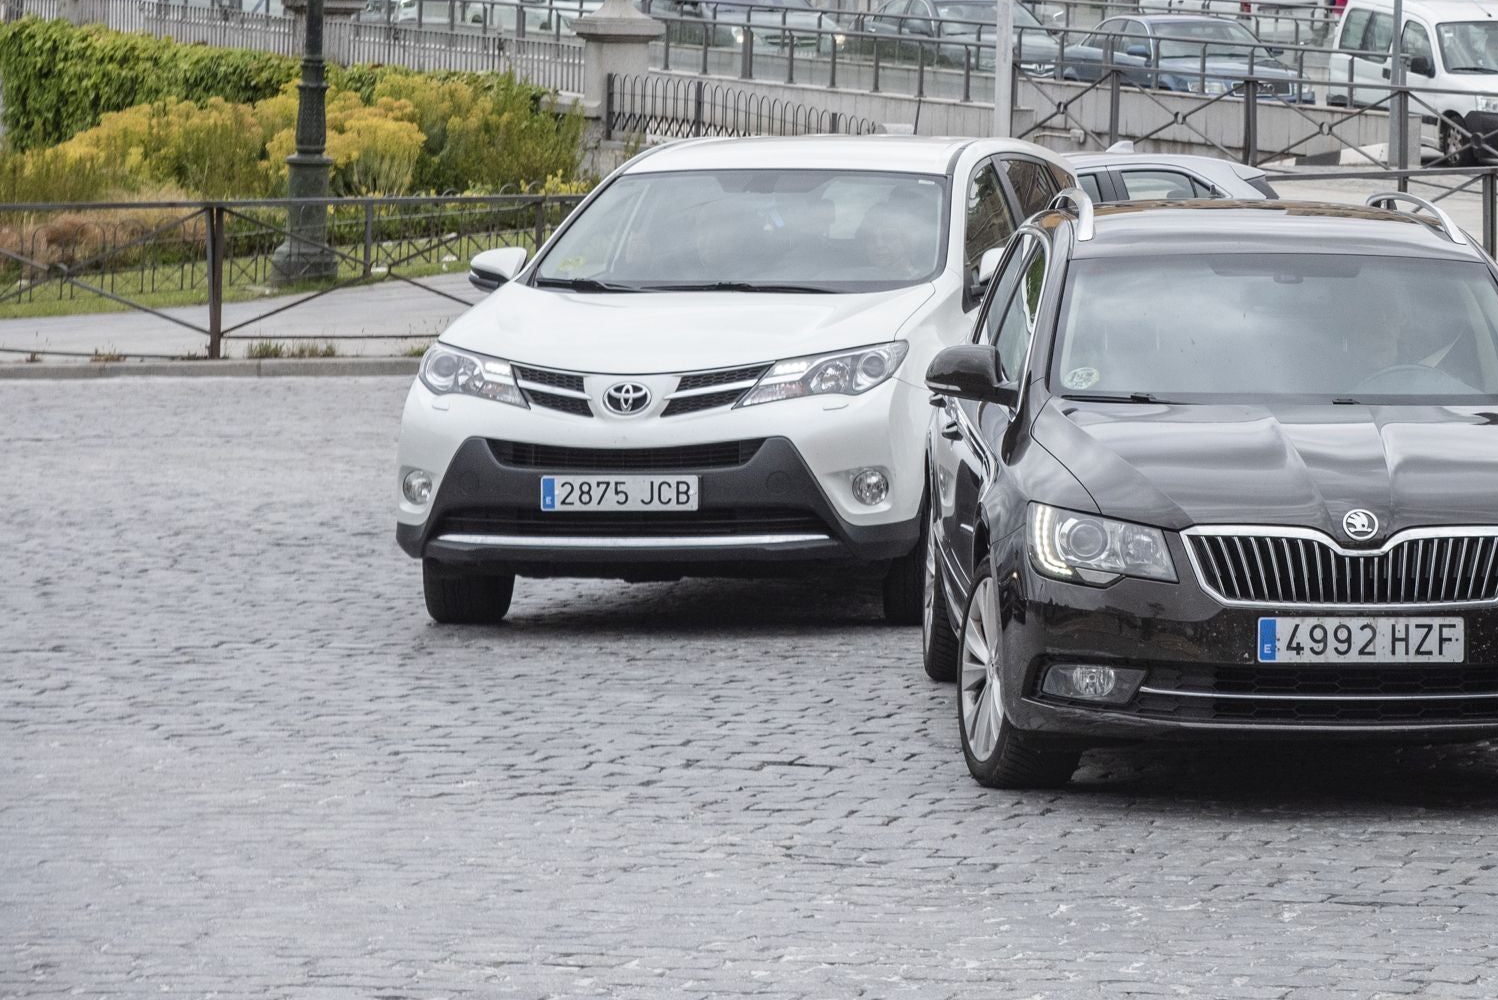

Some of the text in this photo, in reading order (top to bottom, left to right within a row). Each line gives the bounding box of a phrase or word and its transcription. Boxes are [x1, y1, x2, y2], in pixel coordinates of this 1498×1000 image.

[545, 480, 691, 506] E 2875 JCB
[1264, 624, 1457, 656] E 4992 HZF
